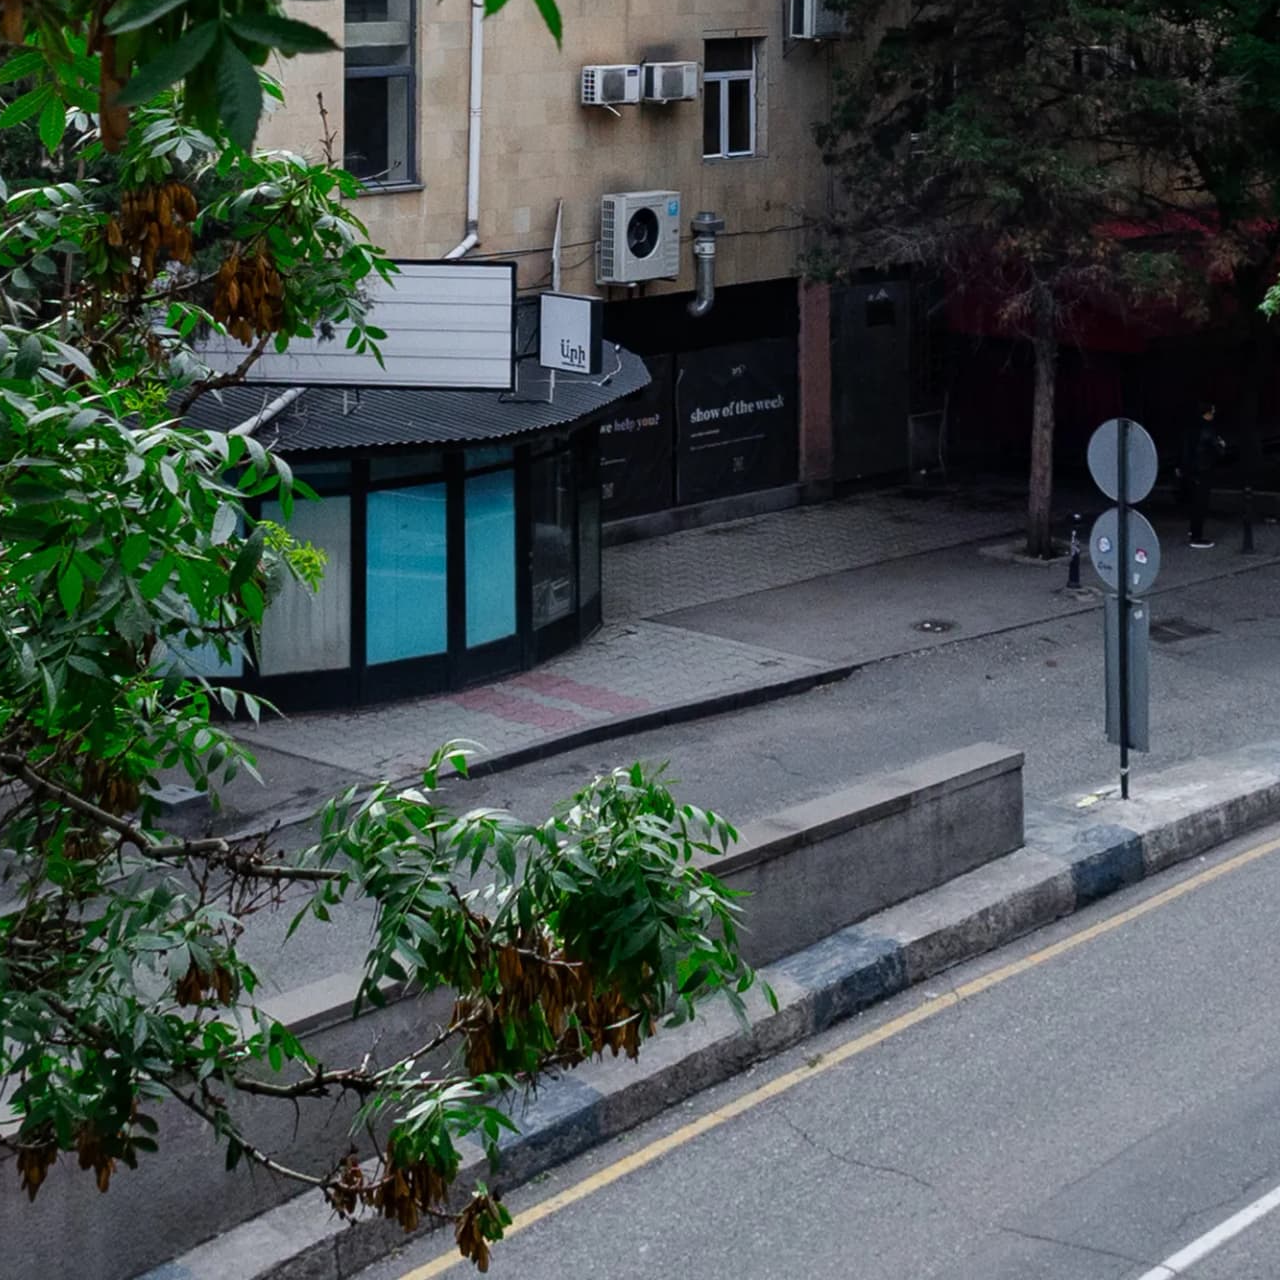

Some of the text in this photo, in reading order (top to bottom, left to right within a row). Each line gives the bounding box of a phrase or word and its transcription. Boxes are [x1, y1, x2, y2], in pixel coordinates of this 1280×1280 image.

[690, 394, 784, 423] show of the week
[614, 418, 635, 431] help
